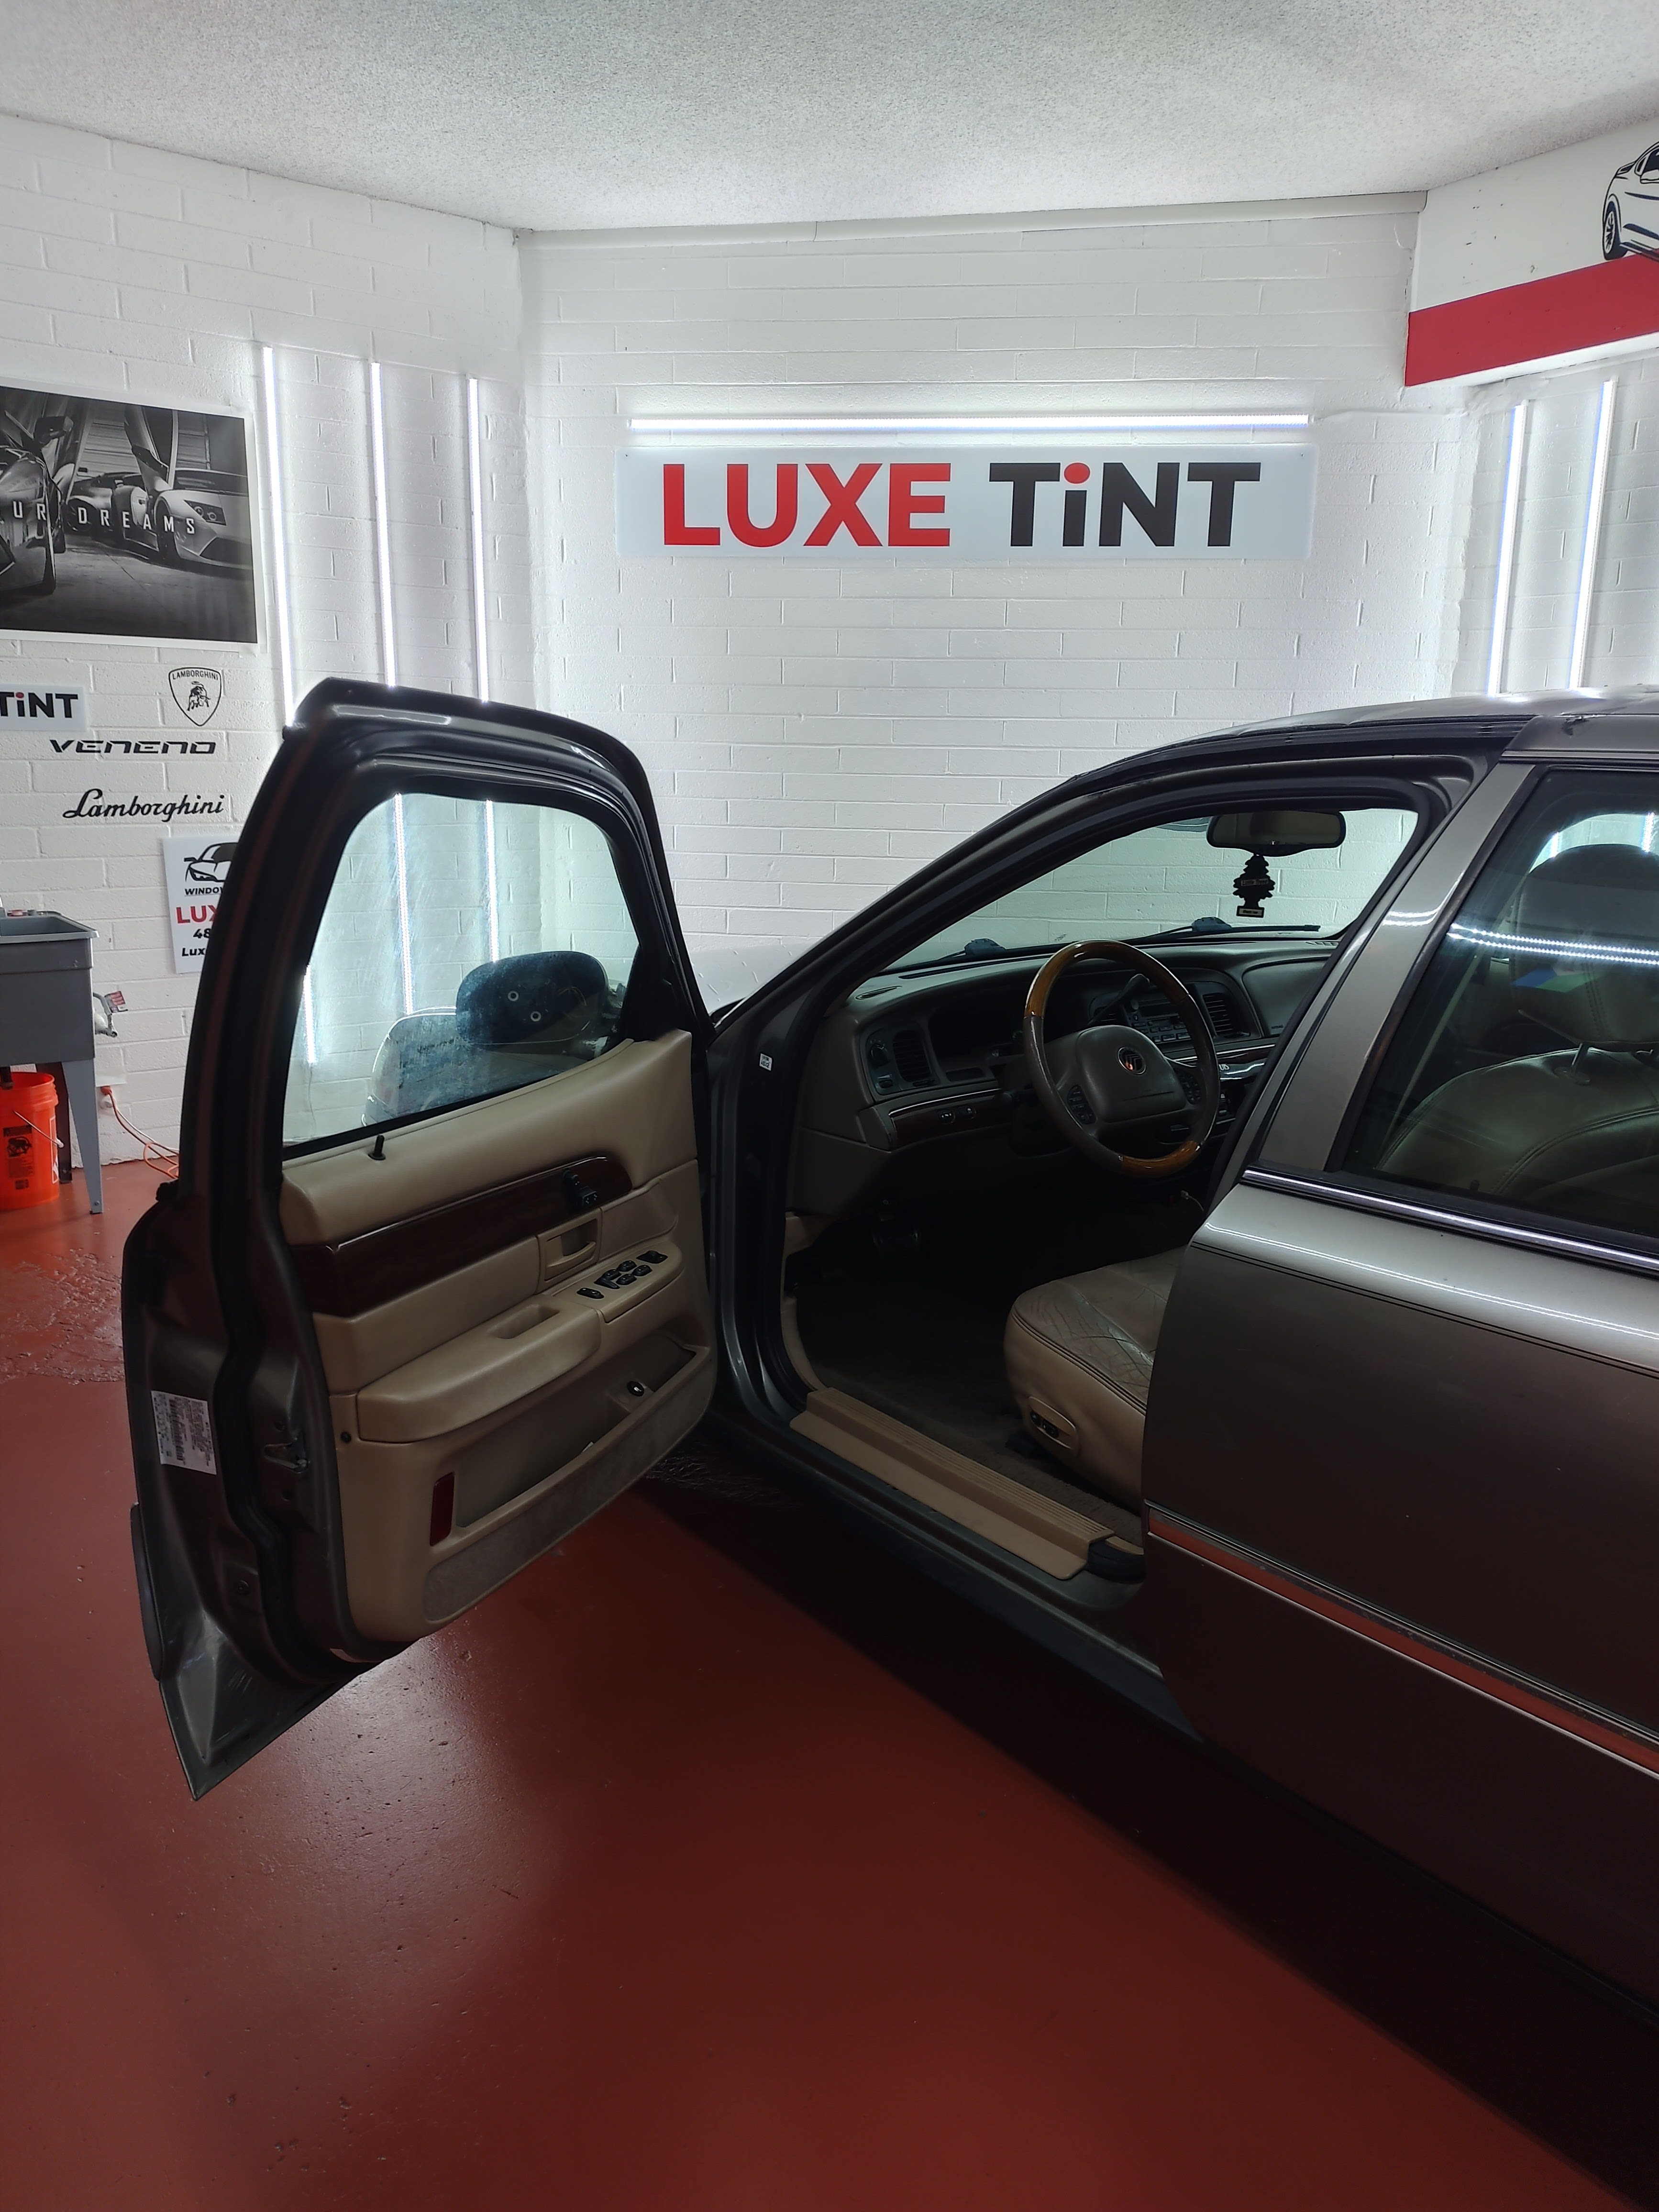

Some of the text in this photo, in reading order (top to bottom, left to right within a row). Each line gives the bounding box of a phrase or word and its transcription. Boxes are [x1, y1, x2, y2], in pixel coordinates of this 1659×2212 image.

[78, 507, 195, 534] DREAMS
[664, 463, 951, 548] LUXE
[173, 670, 218, 680] LAMBORGHINI
[63, 788, 224, 822] Lamborghini
